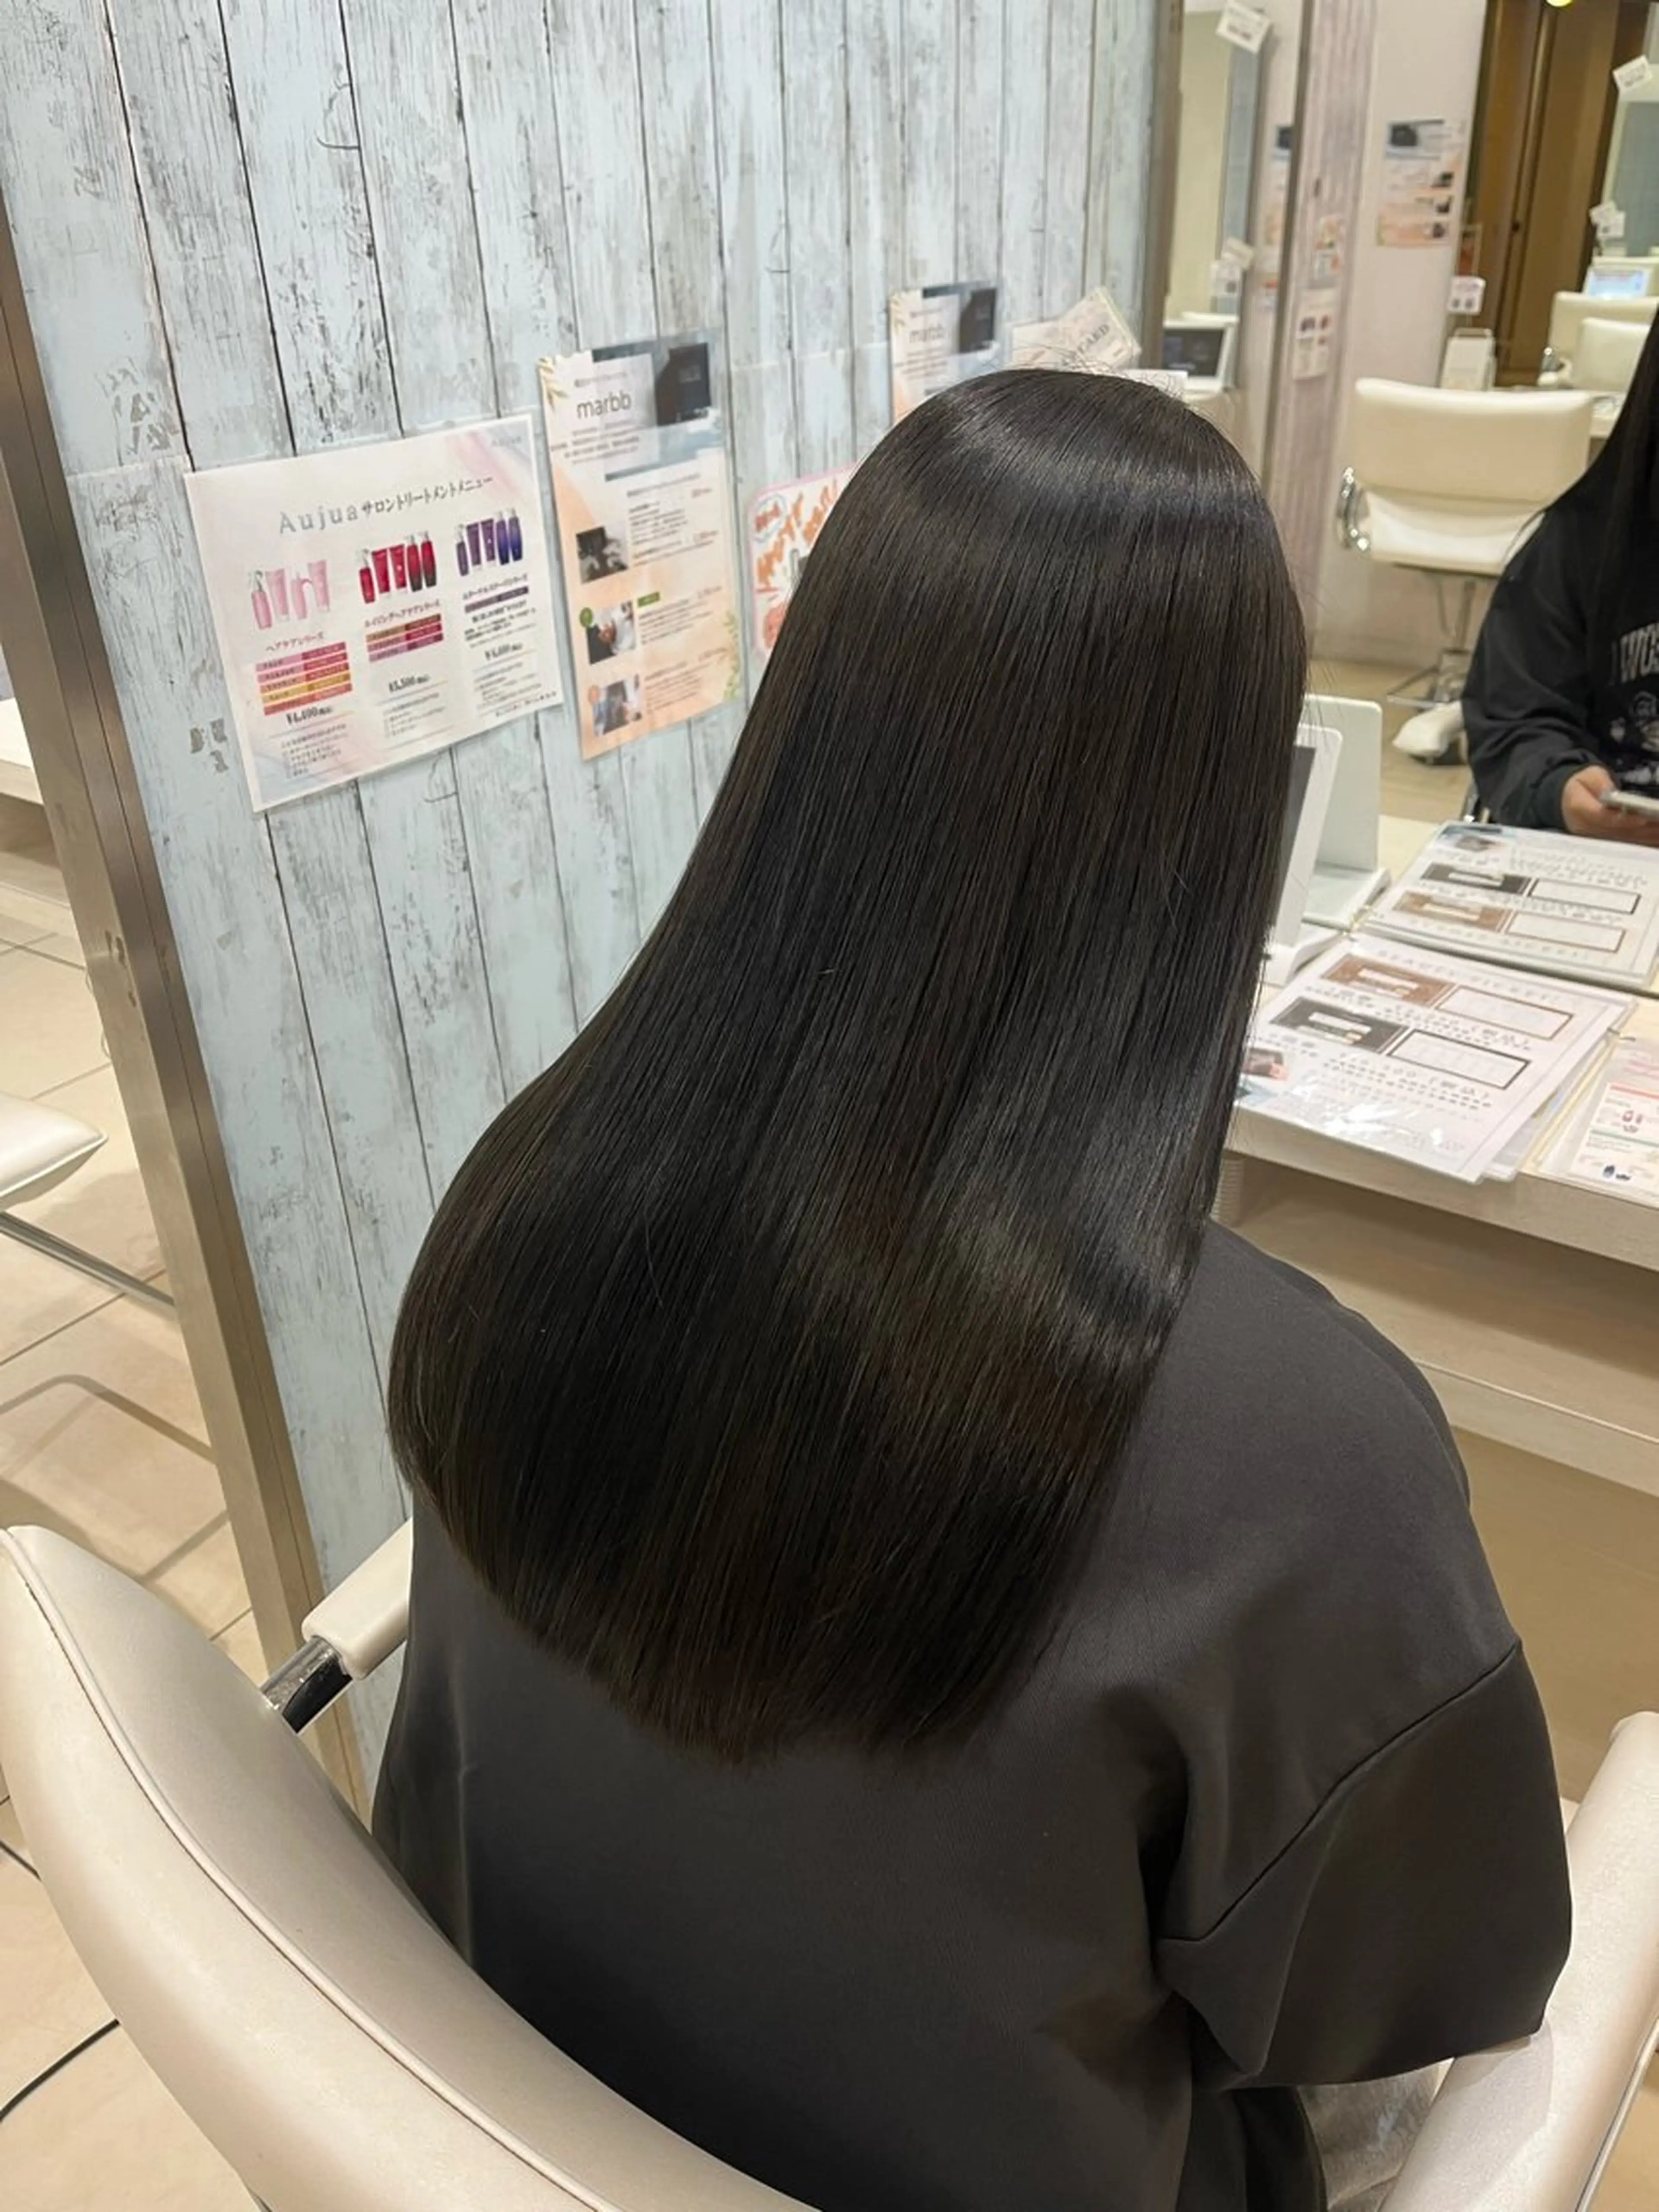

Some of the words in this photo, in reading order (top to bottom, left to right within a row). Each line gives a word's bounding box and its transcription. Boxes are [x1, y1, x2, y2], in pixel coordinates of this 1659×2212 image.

[577, 389, 632, 419] marbb
[280, 505, 359, 534] Aujua
[361, 477, 493, 518] サロントリートメントメニュー
